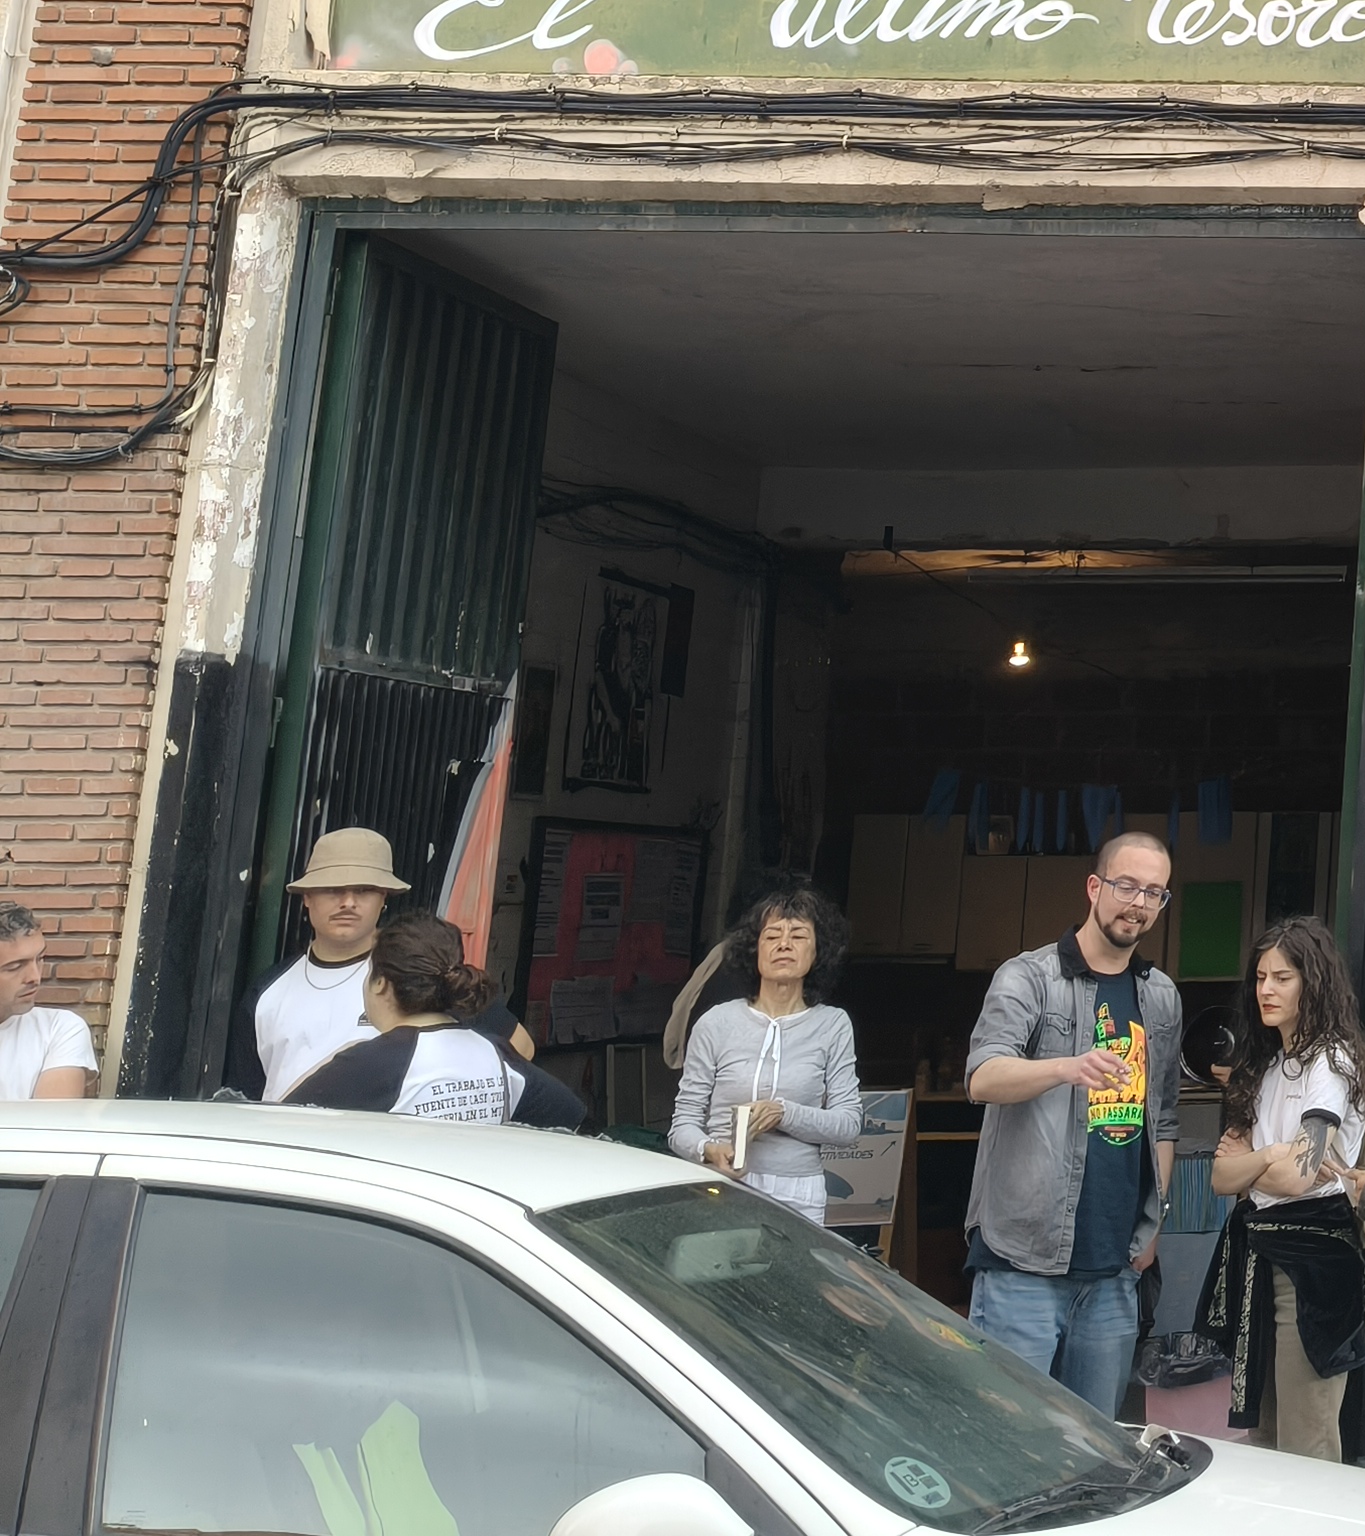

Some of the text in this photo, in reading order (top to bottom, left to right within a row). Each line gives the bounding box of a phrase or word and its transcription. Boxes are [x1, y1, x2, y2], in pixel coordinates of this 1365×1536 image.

[431, 1084, 444, 1096] EL
[445, 1078, 485, 1094] TRABAJO
[485, 1077, 496, 1088] ES
[414, 1097, 456, 1116] FUENTE
[457, 1095, 467, 1107] DE
[469, 1093, 488, 1105] CASI
[479, 1108, 488, 1119] EL
